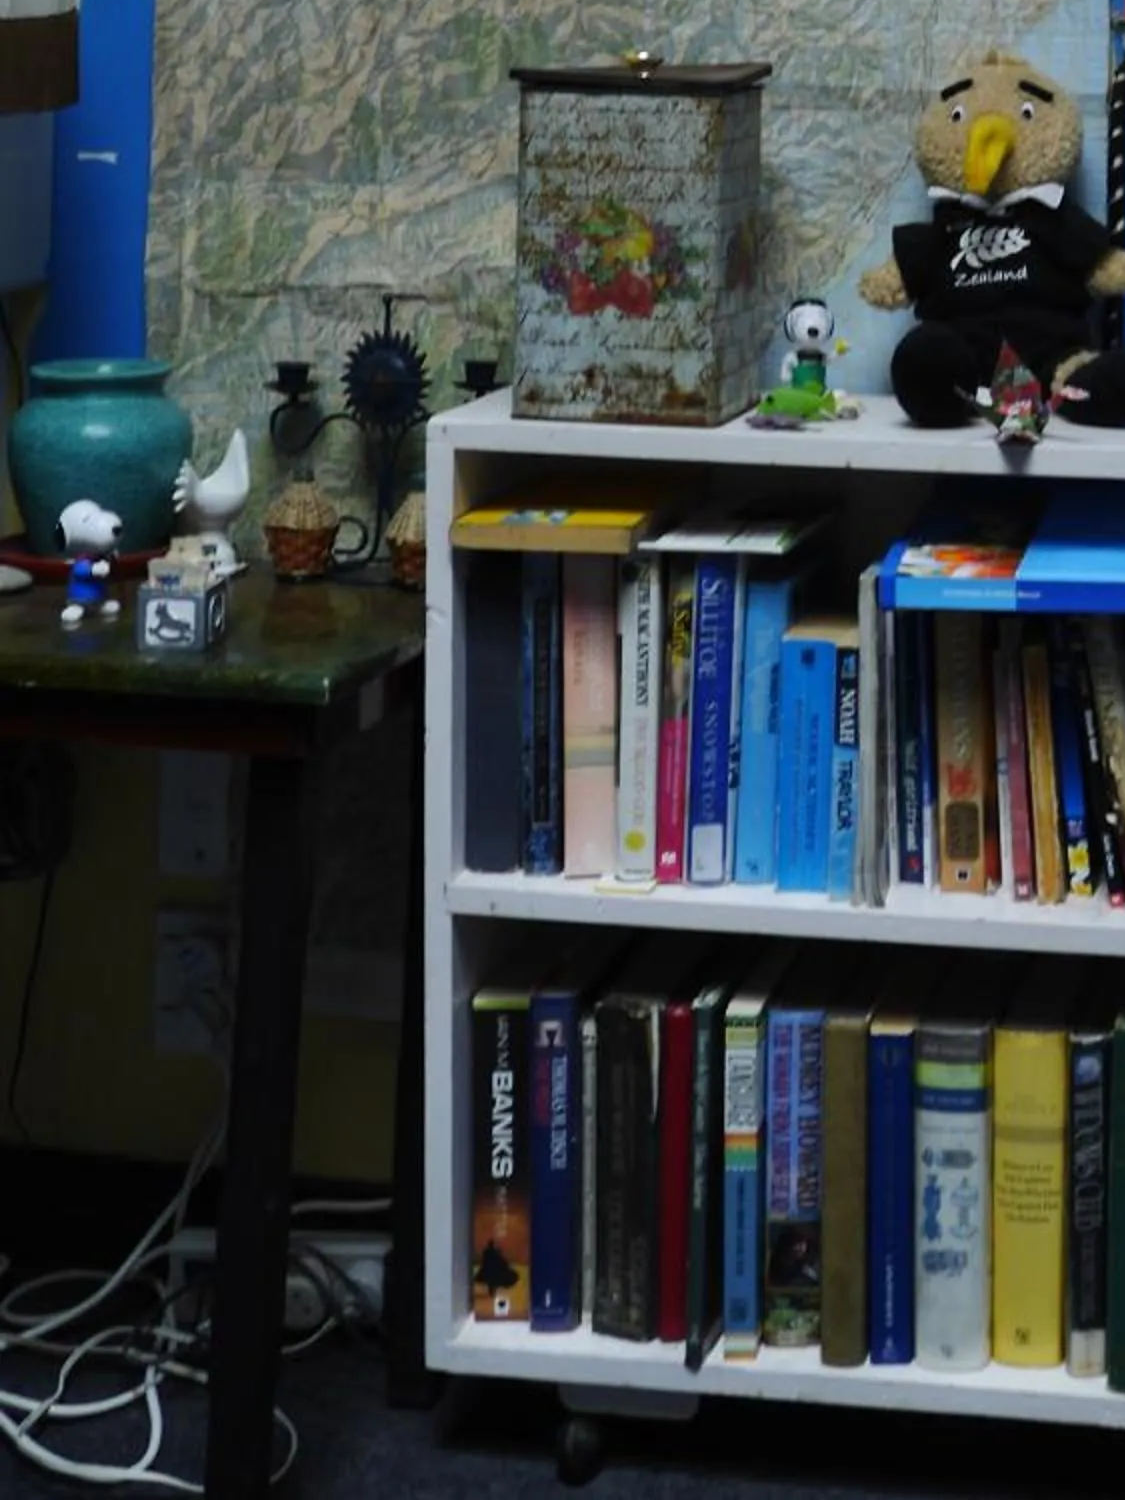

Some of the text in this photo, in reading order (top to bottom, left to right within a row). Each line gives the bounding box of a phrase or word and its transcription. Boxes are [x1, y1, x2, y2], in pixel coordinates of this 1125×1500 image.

[954, 264, 1028, 288] Zealand
[698, 576, 727, 680] SILLITOE
[701, 700, 718, 823] SNOWSTOP
[840, 688, 856, 745] NOAH
[492, 1070, 513, 1179] BANKS
